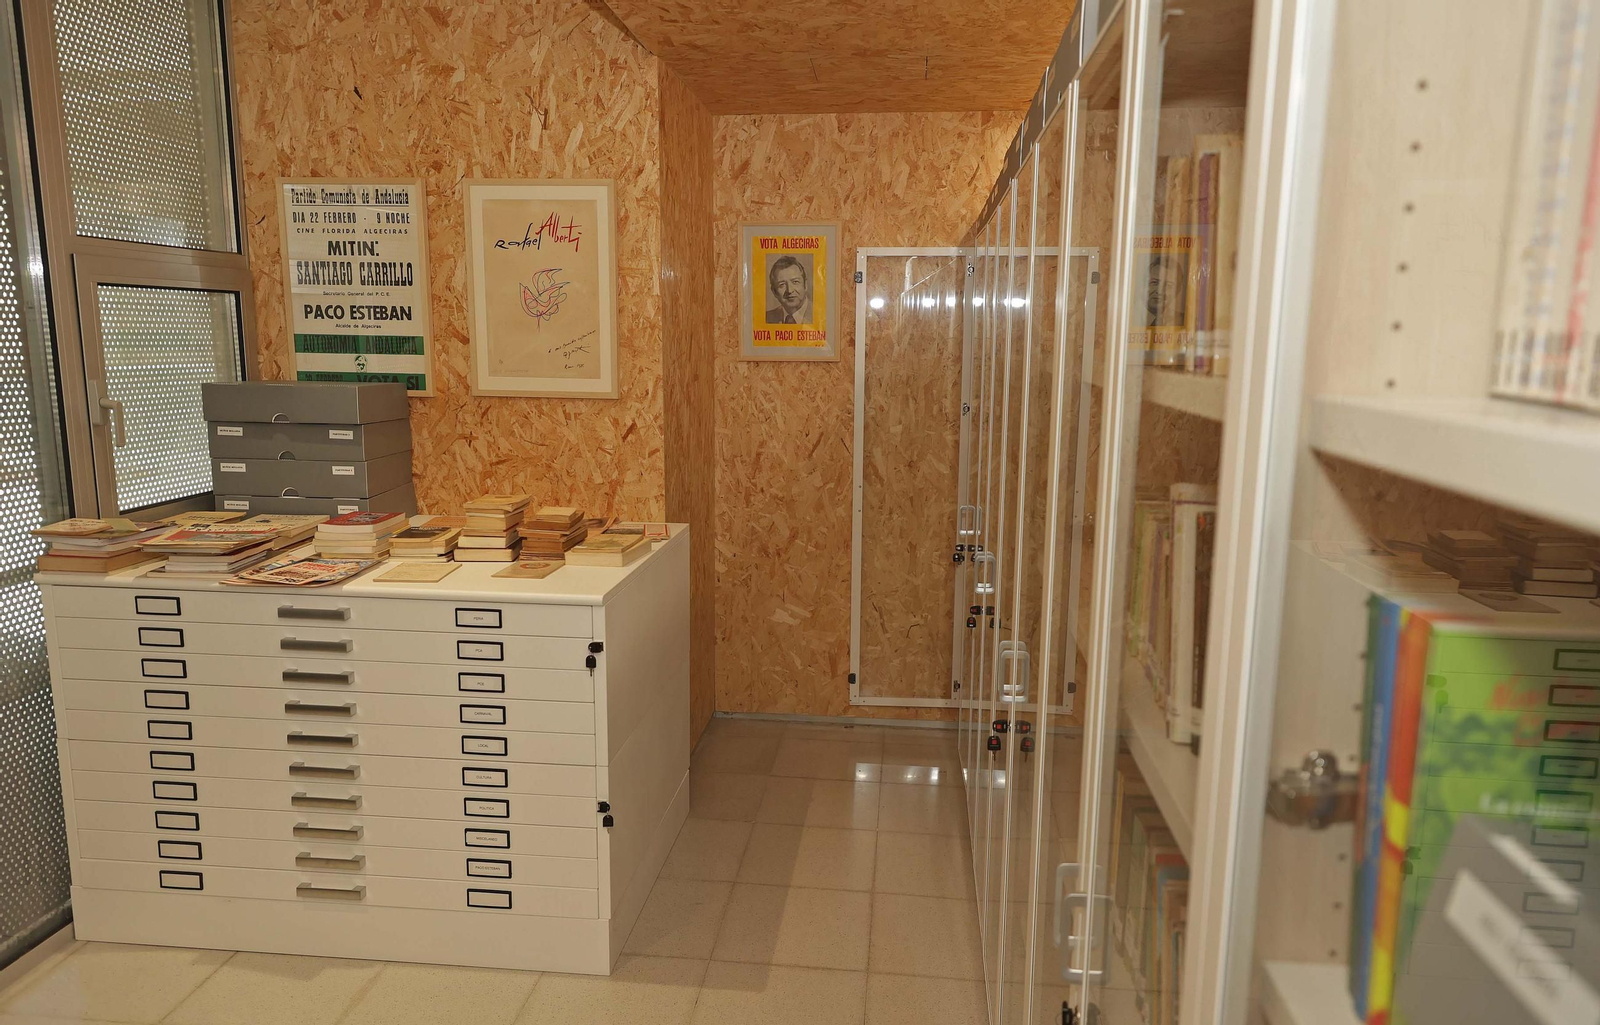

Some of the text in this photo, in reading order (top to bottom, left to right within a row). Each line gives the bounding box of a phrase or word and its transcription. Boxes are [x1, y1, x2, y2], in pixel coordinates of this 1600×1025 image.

[291, 188, 409, 204] Partido Comunista de Andalucía
[292, 211, 306, 223] DIA
[310, 212, 319, 224] 22
[323, 212, 357, 224] FEBRERO
[376, 212, 381, 224] 9
[385, 212, 410, 224] NOCHE
[494, 212, 582, 252] Rafael Alberti
[760, 238, 819, 249] VOTA ALGECIRAS
[296, 261, 413, 287] SANTIAGO CARRILLO
[304, 304, 412, 321] PACO ESTEBAN
[753, 330, 826, 341] VOTA PACO ESTEBAN
[406, 375, 419, 390] SI
